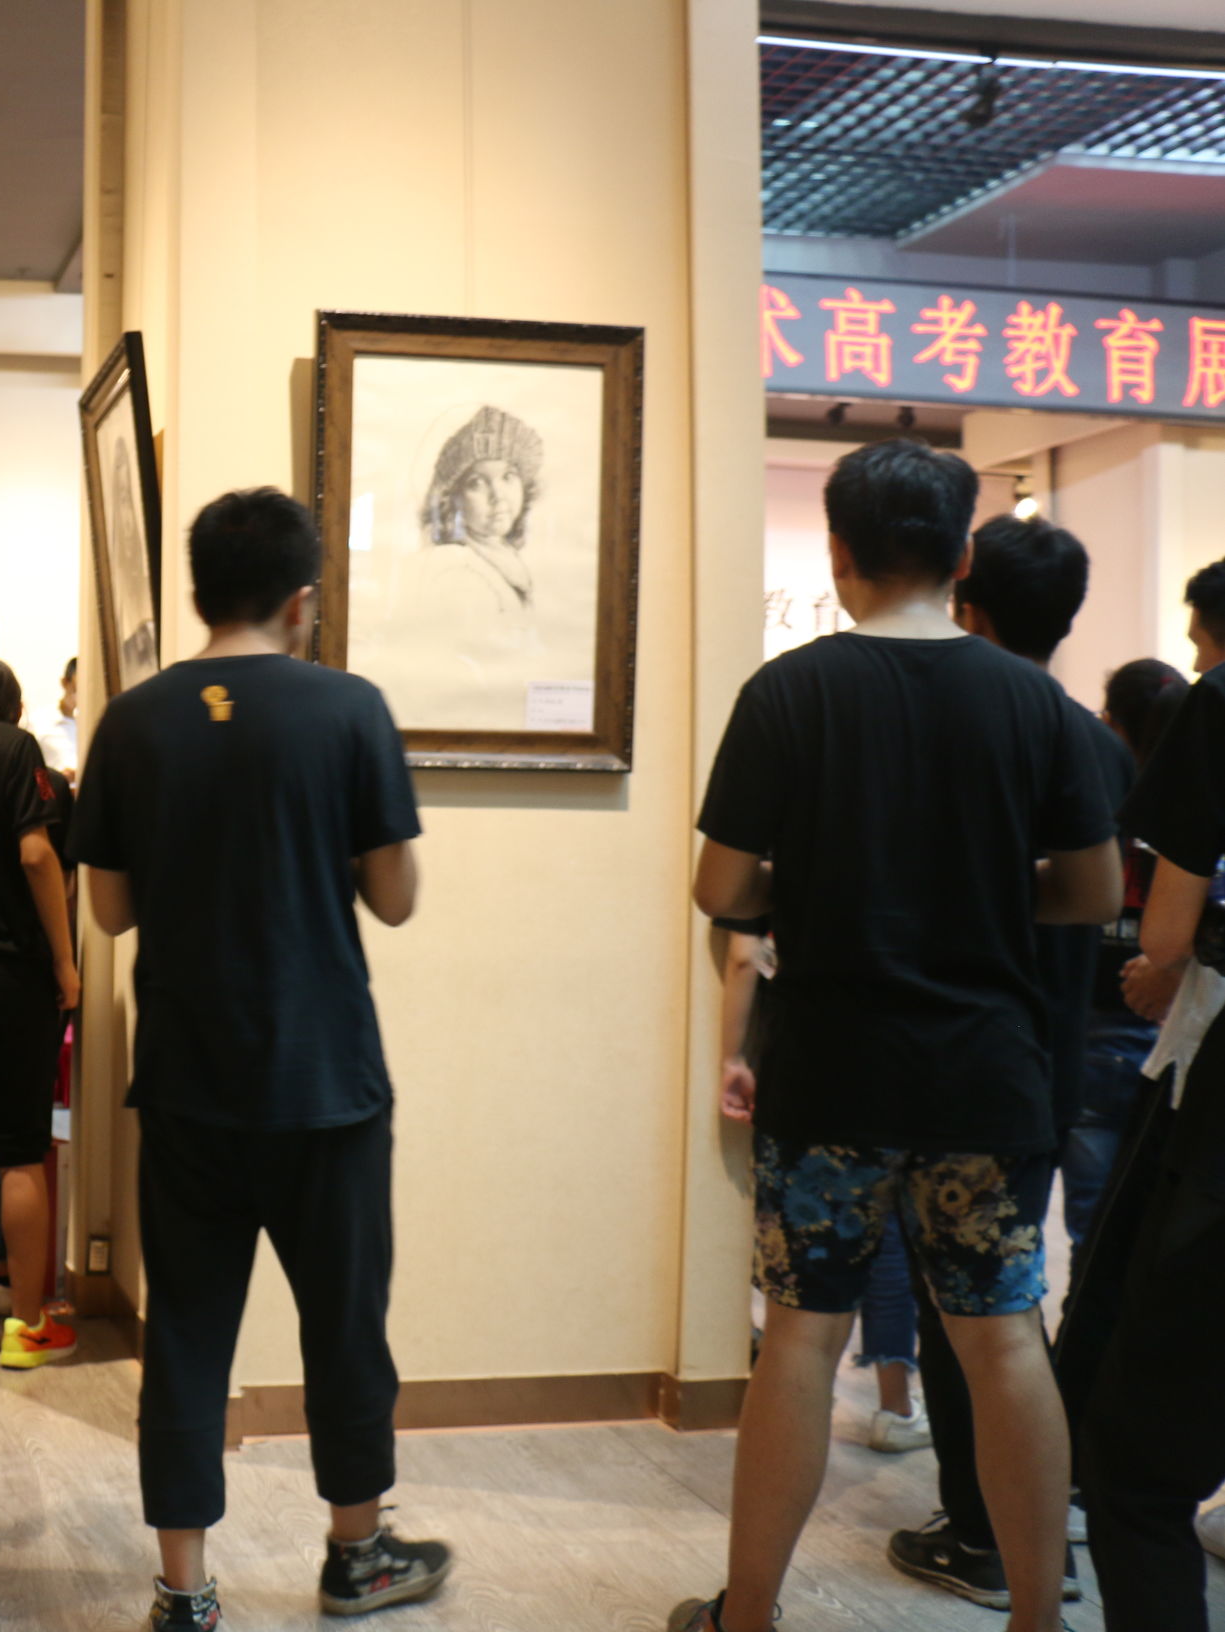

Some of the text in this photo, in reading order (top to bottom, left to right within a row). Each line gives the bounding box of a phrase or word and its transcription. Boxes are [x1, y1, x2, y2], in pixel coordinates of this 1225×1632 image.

[759, 284, 1225, 406] 术高考教育展
